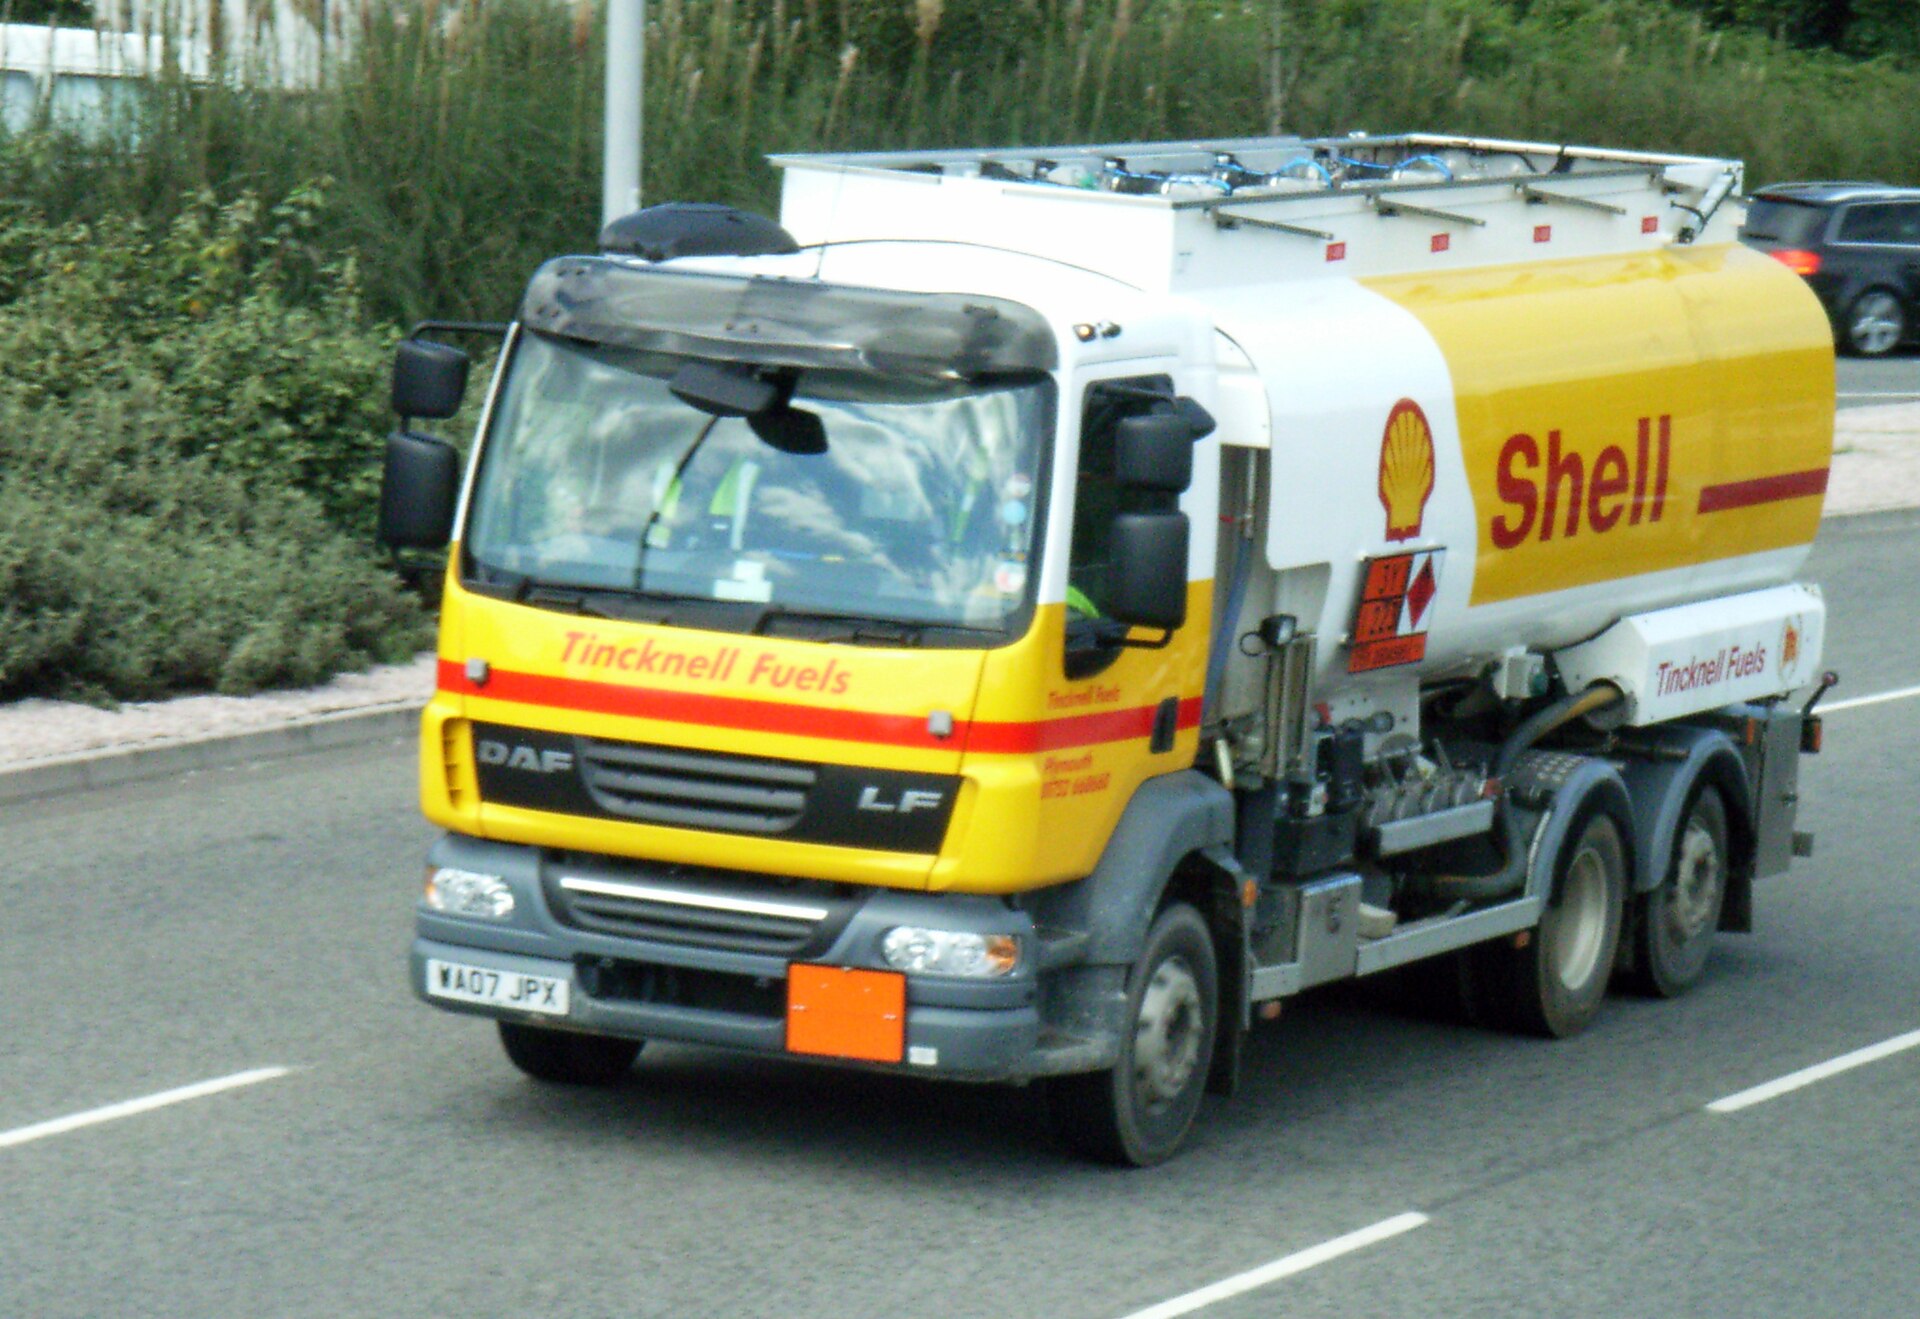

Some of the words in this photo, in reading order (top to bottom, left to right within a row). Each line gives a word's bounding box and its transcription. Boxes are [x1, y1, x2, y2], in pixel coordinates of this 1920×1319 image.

[1491, 414, 1671, 549] Shell
[560, 631, 741, 682] Tincknell
[748, 653, 852, 695] Fuels
[1657, 649, 1725, 696] Tincknell
[1726, 641, 1766, 680] Fuels
[476, 739, 574, 774] DAF
[856, 787, 943, 814] LF
[439, 965, 499, 997] WA07
[510, 976, 557, 1006] JPX
